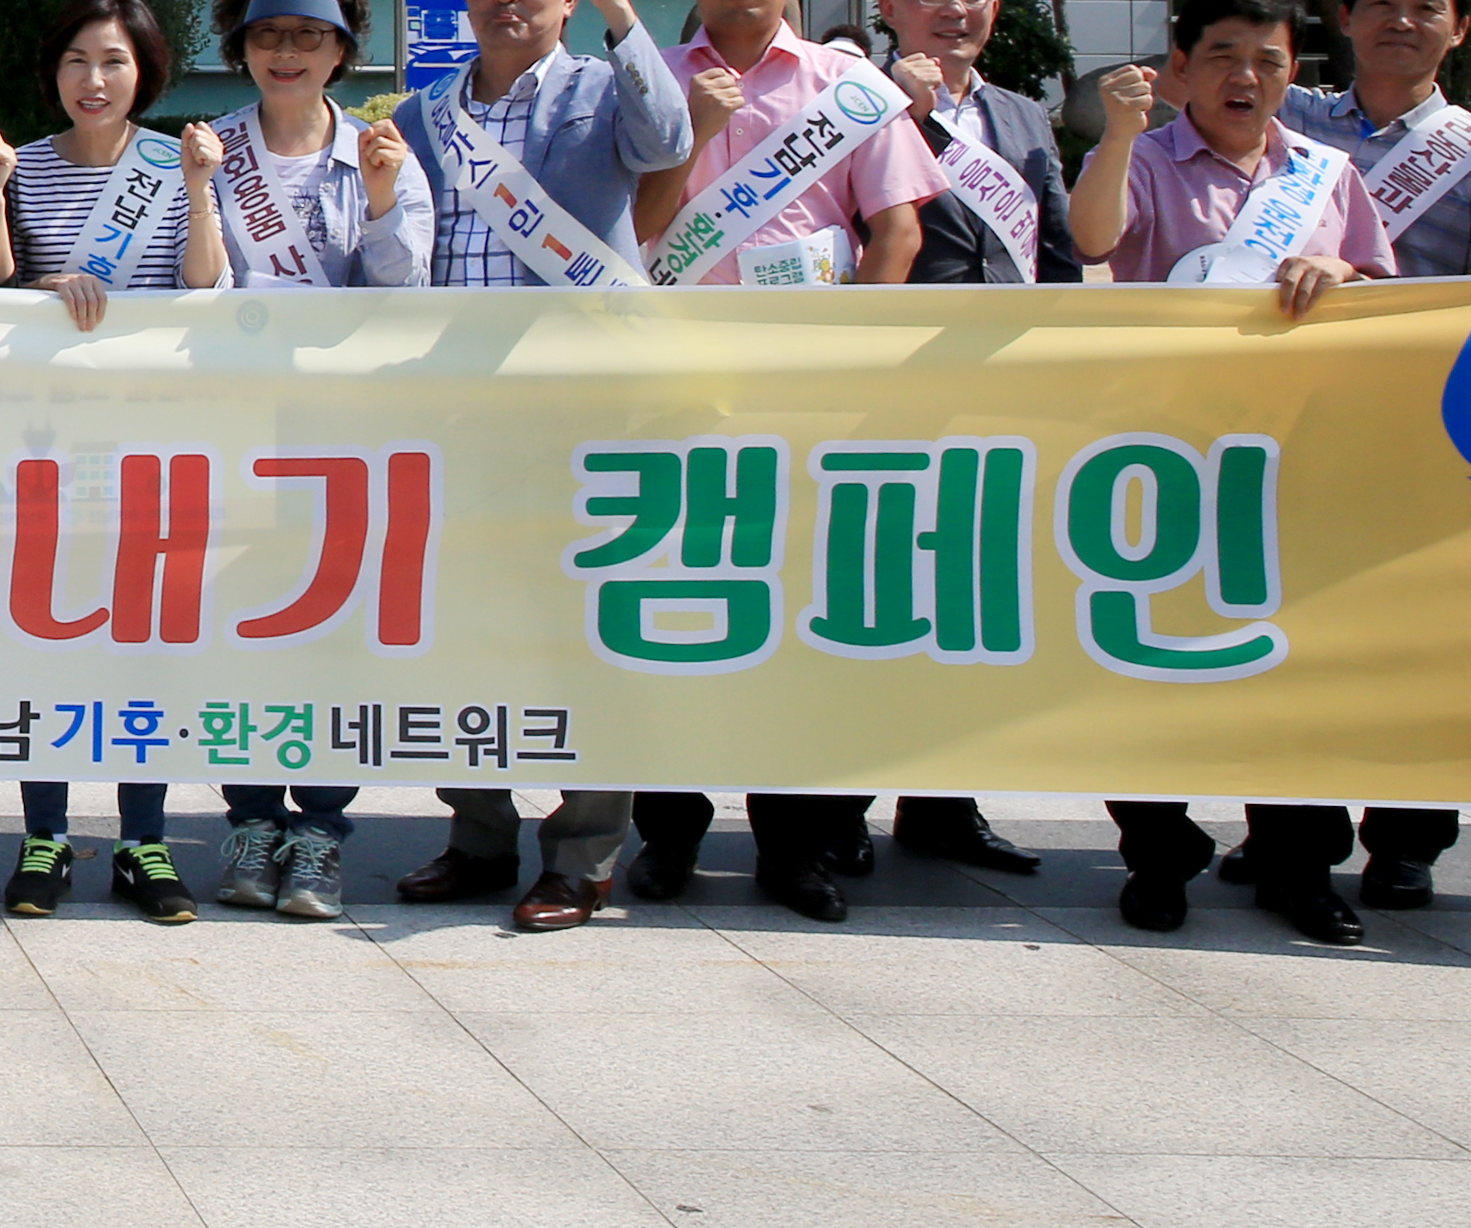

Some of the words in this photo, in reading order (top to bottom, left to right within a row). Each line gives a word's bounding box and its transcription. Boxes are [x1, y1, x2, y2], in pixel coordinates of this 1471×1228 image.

[215, 121, 288, 240] 일회용품
[959, 158, 1024, 222] 음식은
[754, 256, 801, 278] 탄소중립
[576, 446, 1274, 669] 캠페인
